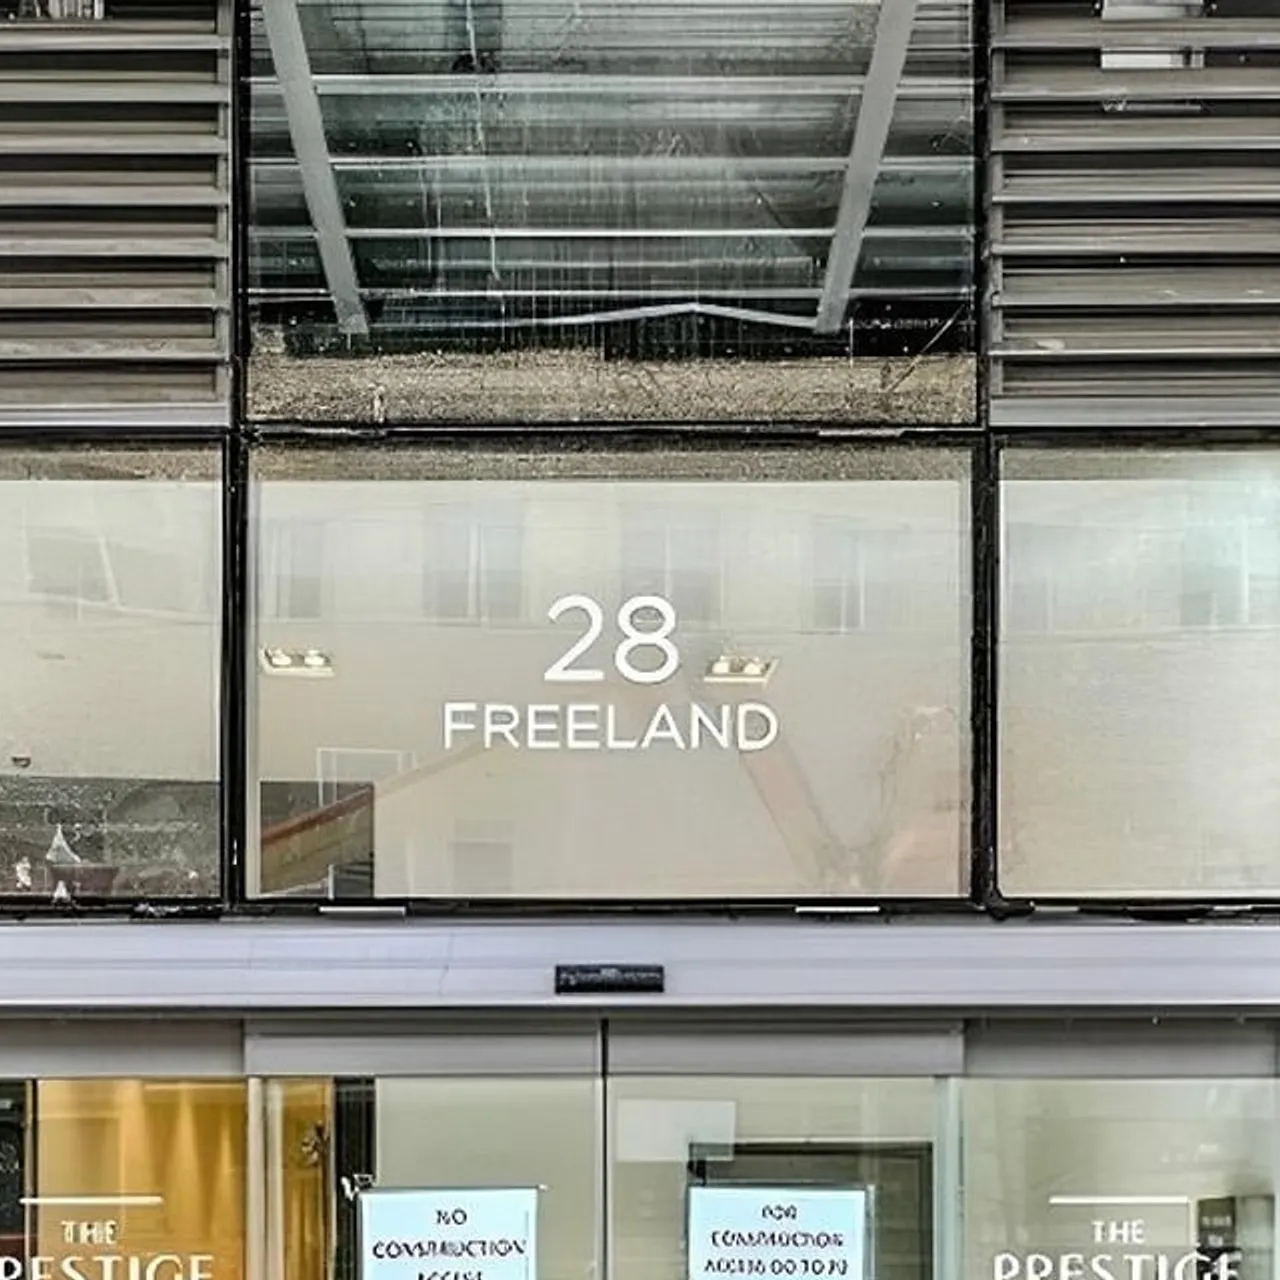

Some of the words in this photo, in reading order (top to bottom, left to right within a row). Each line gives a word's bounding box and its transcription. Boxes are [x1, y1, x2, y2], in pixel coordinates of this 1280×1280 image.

[544, 594, 679, 683] 28
[444, 702, 778, 750] FREELAND
[436, 1209, 467, 1225] NO
[61, 1220, 118, 1244] THE
[1092, 1219, 1145, 1243] THE
